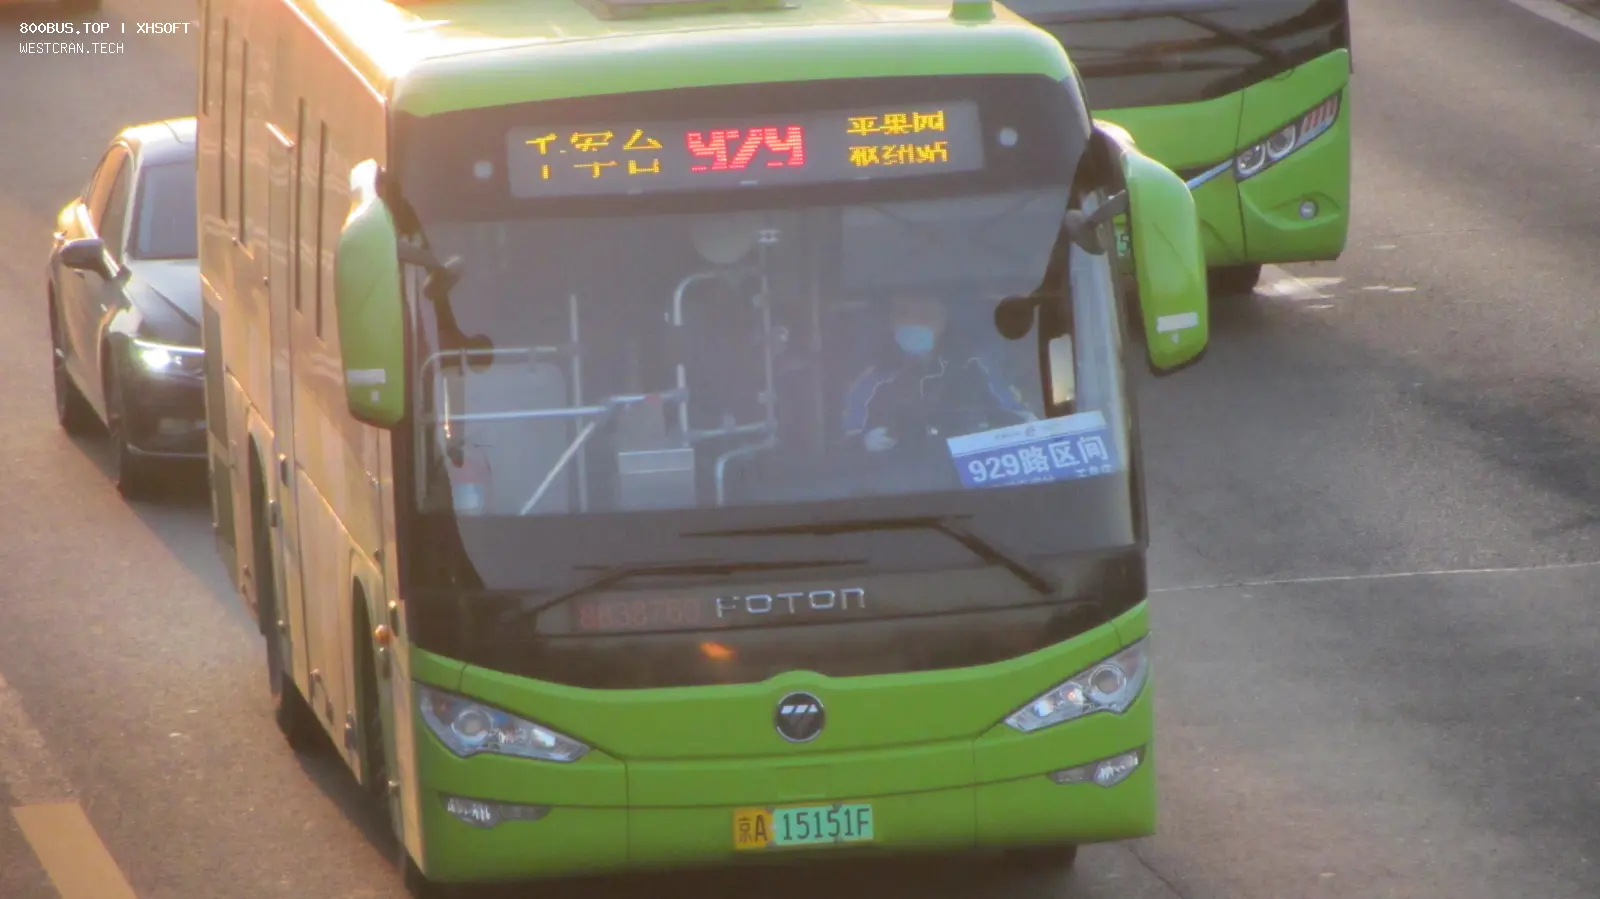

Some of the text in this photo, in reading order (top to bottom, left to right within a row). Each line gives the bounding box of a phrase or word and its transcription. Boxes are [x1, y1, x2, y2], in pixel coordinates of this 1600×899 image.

[967, 435, 1109, 483] 929路区间
[715, 587, 866, 618] FOTON
